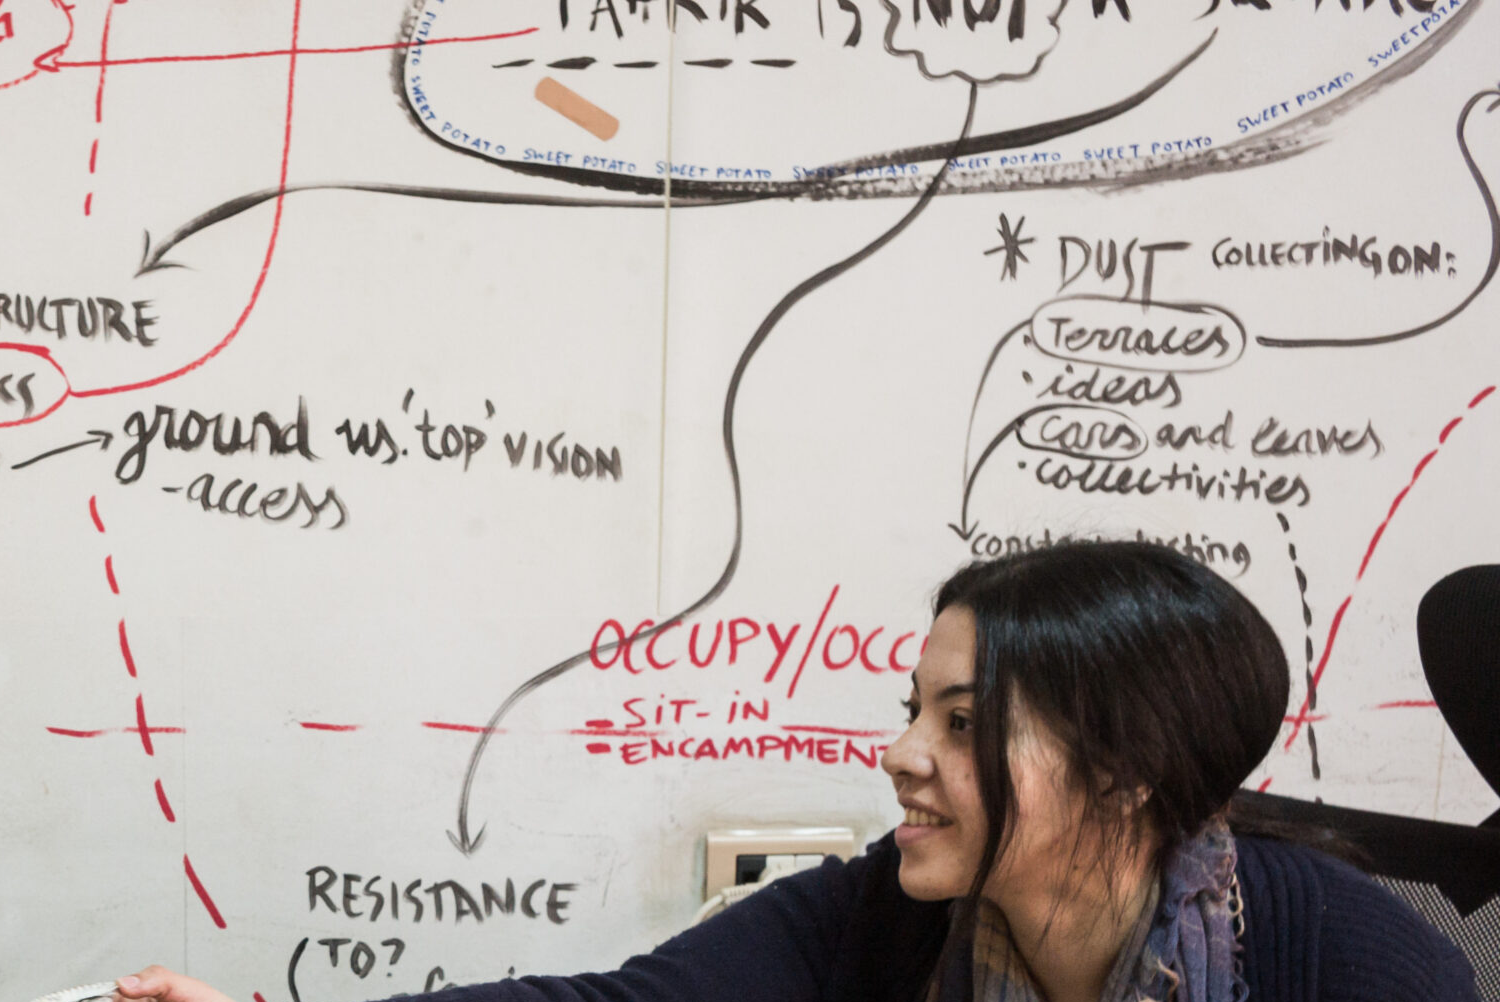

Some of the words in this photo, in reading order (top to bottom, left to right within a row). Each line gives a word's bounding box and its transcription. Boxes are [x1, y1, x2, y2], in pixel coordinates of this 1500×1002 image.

[411, 75, 437, 122] SWEET
[441, 121, 507, 155] POTATO
[522, 147, 573, 165] SWEET
[582, 155, 637, 174] POTATO
[655, 160, 709, 178] SWEET
[715, 166, 773, 180] POTATO
[854, 163, 920, 179] POTATO
[948, 156, 993, 171] SWEET
[999, 151, 1062, 167] POTATO
[1082, 143, 1141, 162] SWEET
[1150, 135, 1213, 156] POTATO
[1236, 100, 1291, 135] SWEET
[1295, 70, 1355, 107] POTATO
[1367, 25, 1420, 68] SWEET
[1058, 235, 1194, 313] DUST
[1047, 316, 1231, 358] Terraces
[1037, 363, 1183, 408] ideas
[114, 394, 322, 485] ground
[502, 430, 624, 482] VISION
[1155, 410, 1235, 452] and
[1034, 457, 1312, 508] collectivities
[305, 864, 581, 924] RESISTANCE
